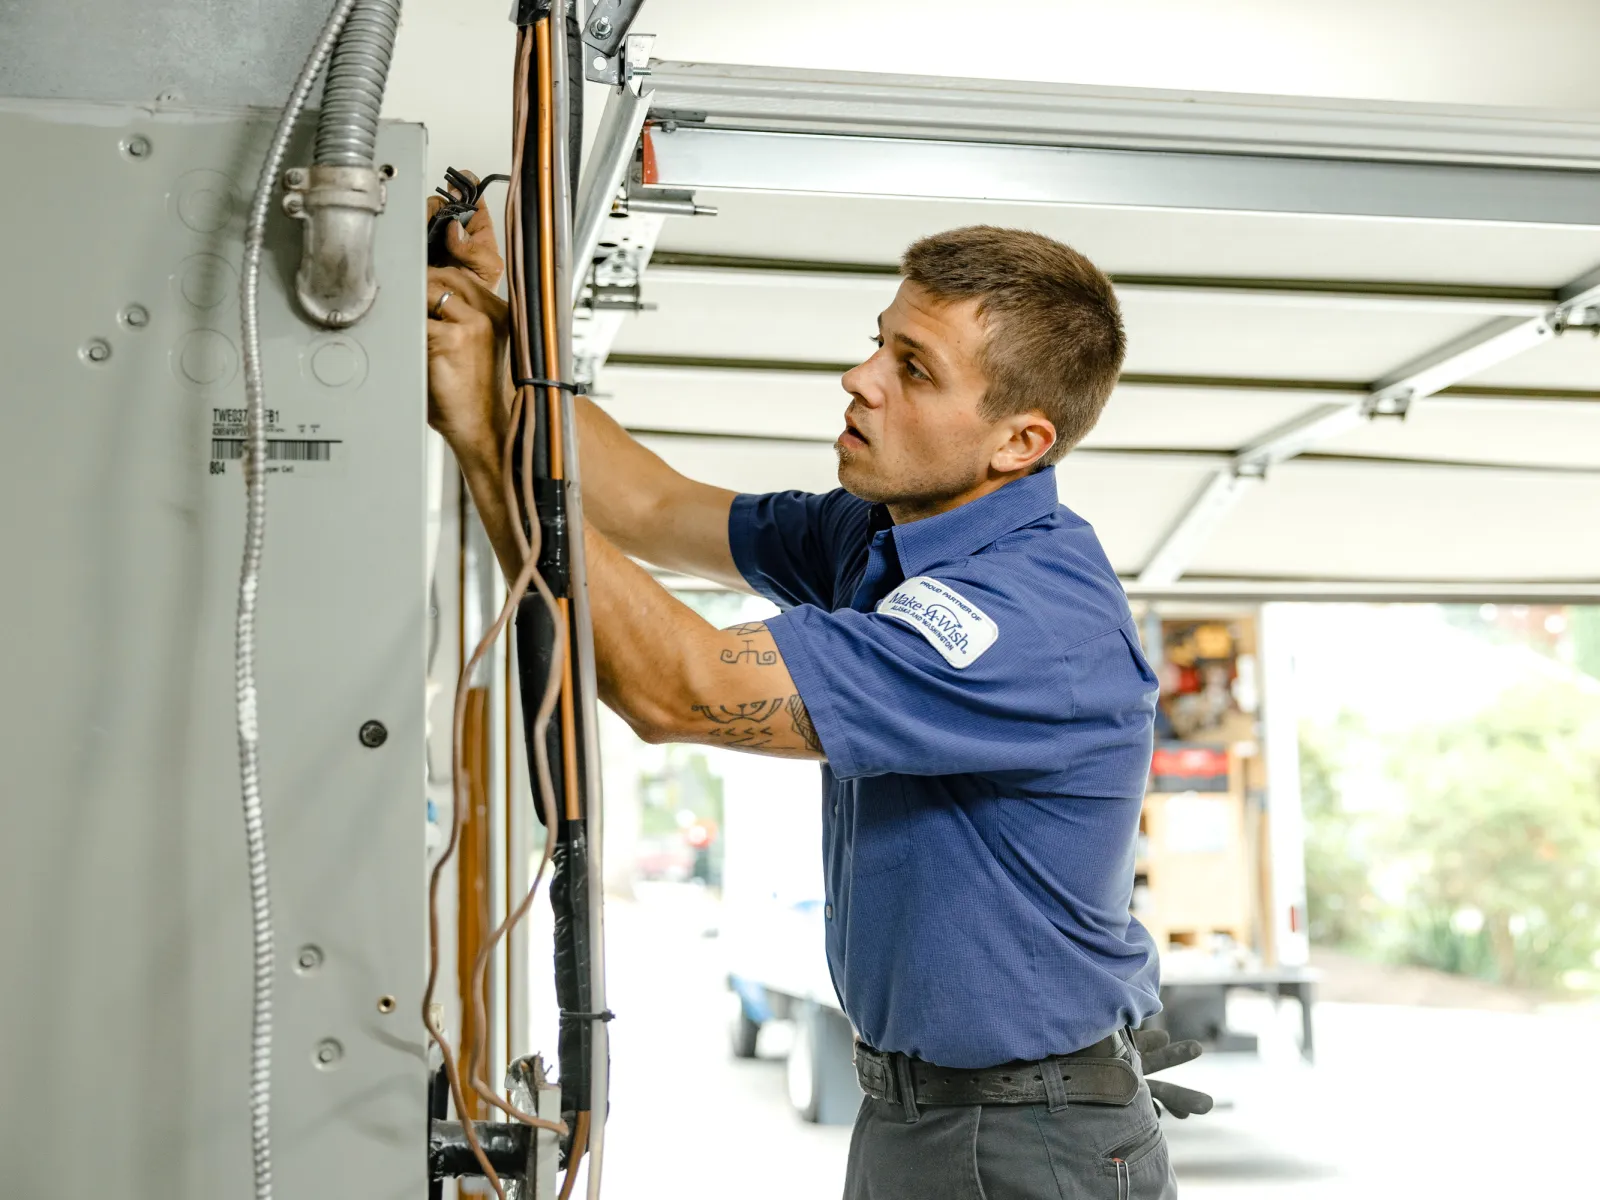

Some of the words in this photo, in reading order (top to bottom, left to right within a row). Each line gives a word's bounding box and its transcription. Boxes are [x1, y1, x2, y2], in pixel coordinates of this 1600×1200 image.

[920, 581, 942, 593] PROUD
[942, 592, 972, 616] PARTNER
[971, 612, 982, 621] OF
[891, 605, 911, 615] ALASKA
[910, 612, 922, 621] AND
[921, 618, 955, 651] WASHINGTON
